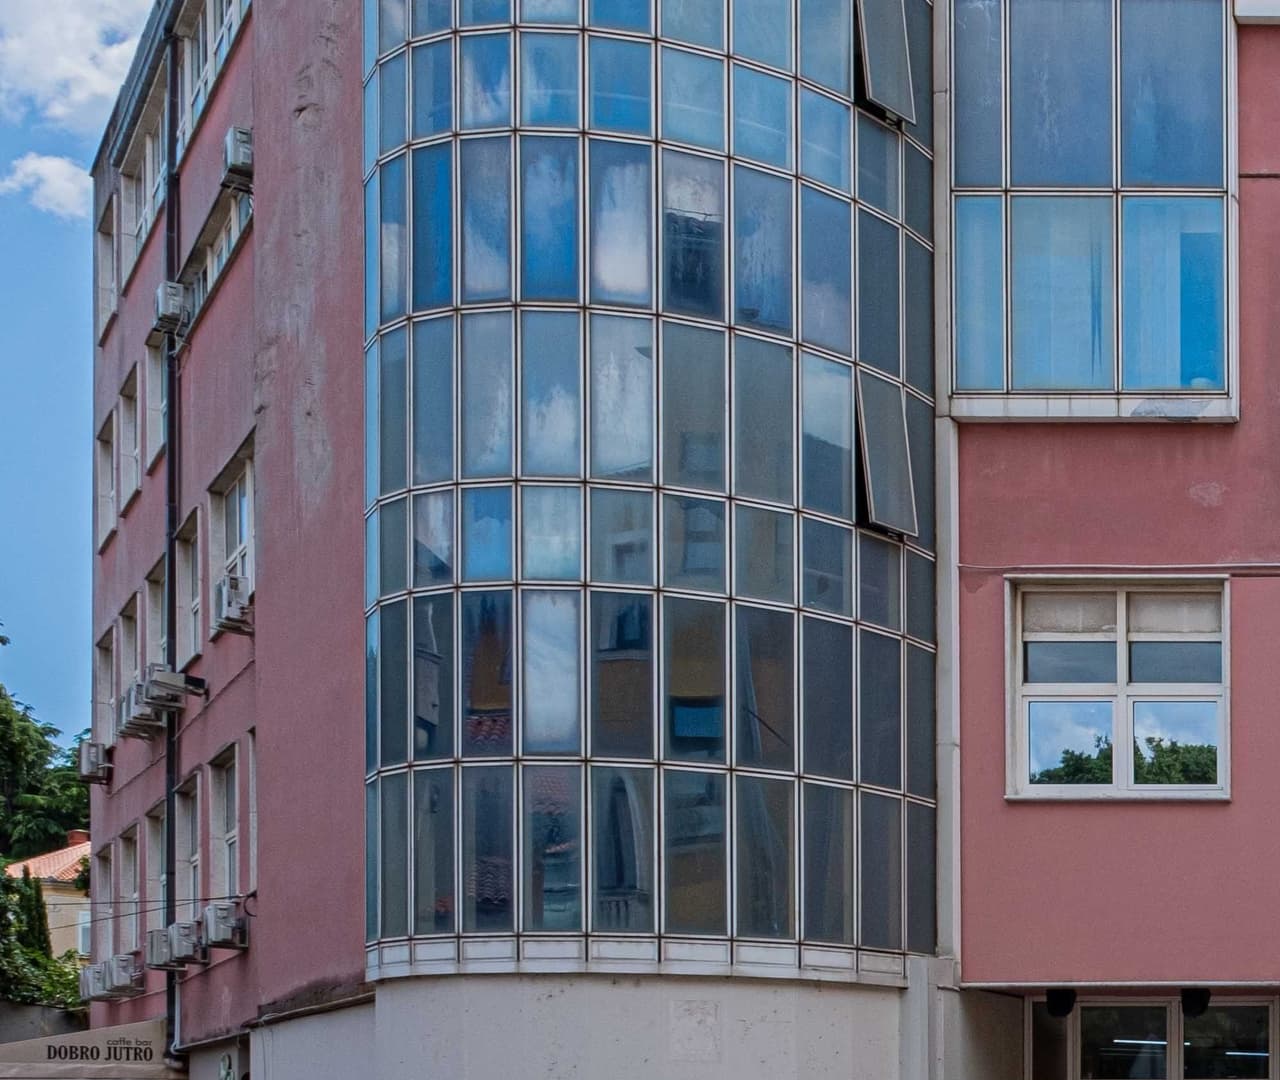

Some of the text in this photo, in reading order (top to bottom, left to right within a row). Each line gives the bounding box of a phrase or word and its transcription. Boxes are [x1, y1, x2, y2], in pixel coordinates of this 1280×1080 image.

[106, 1037, 153, 1046] caffe bar
[47, 1045, 153, 1062] DOBRO JUTRO
